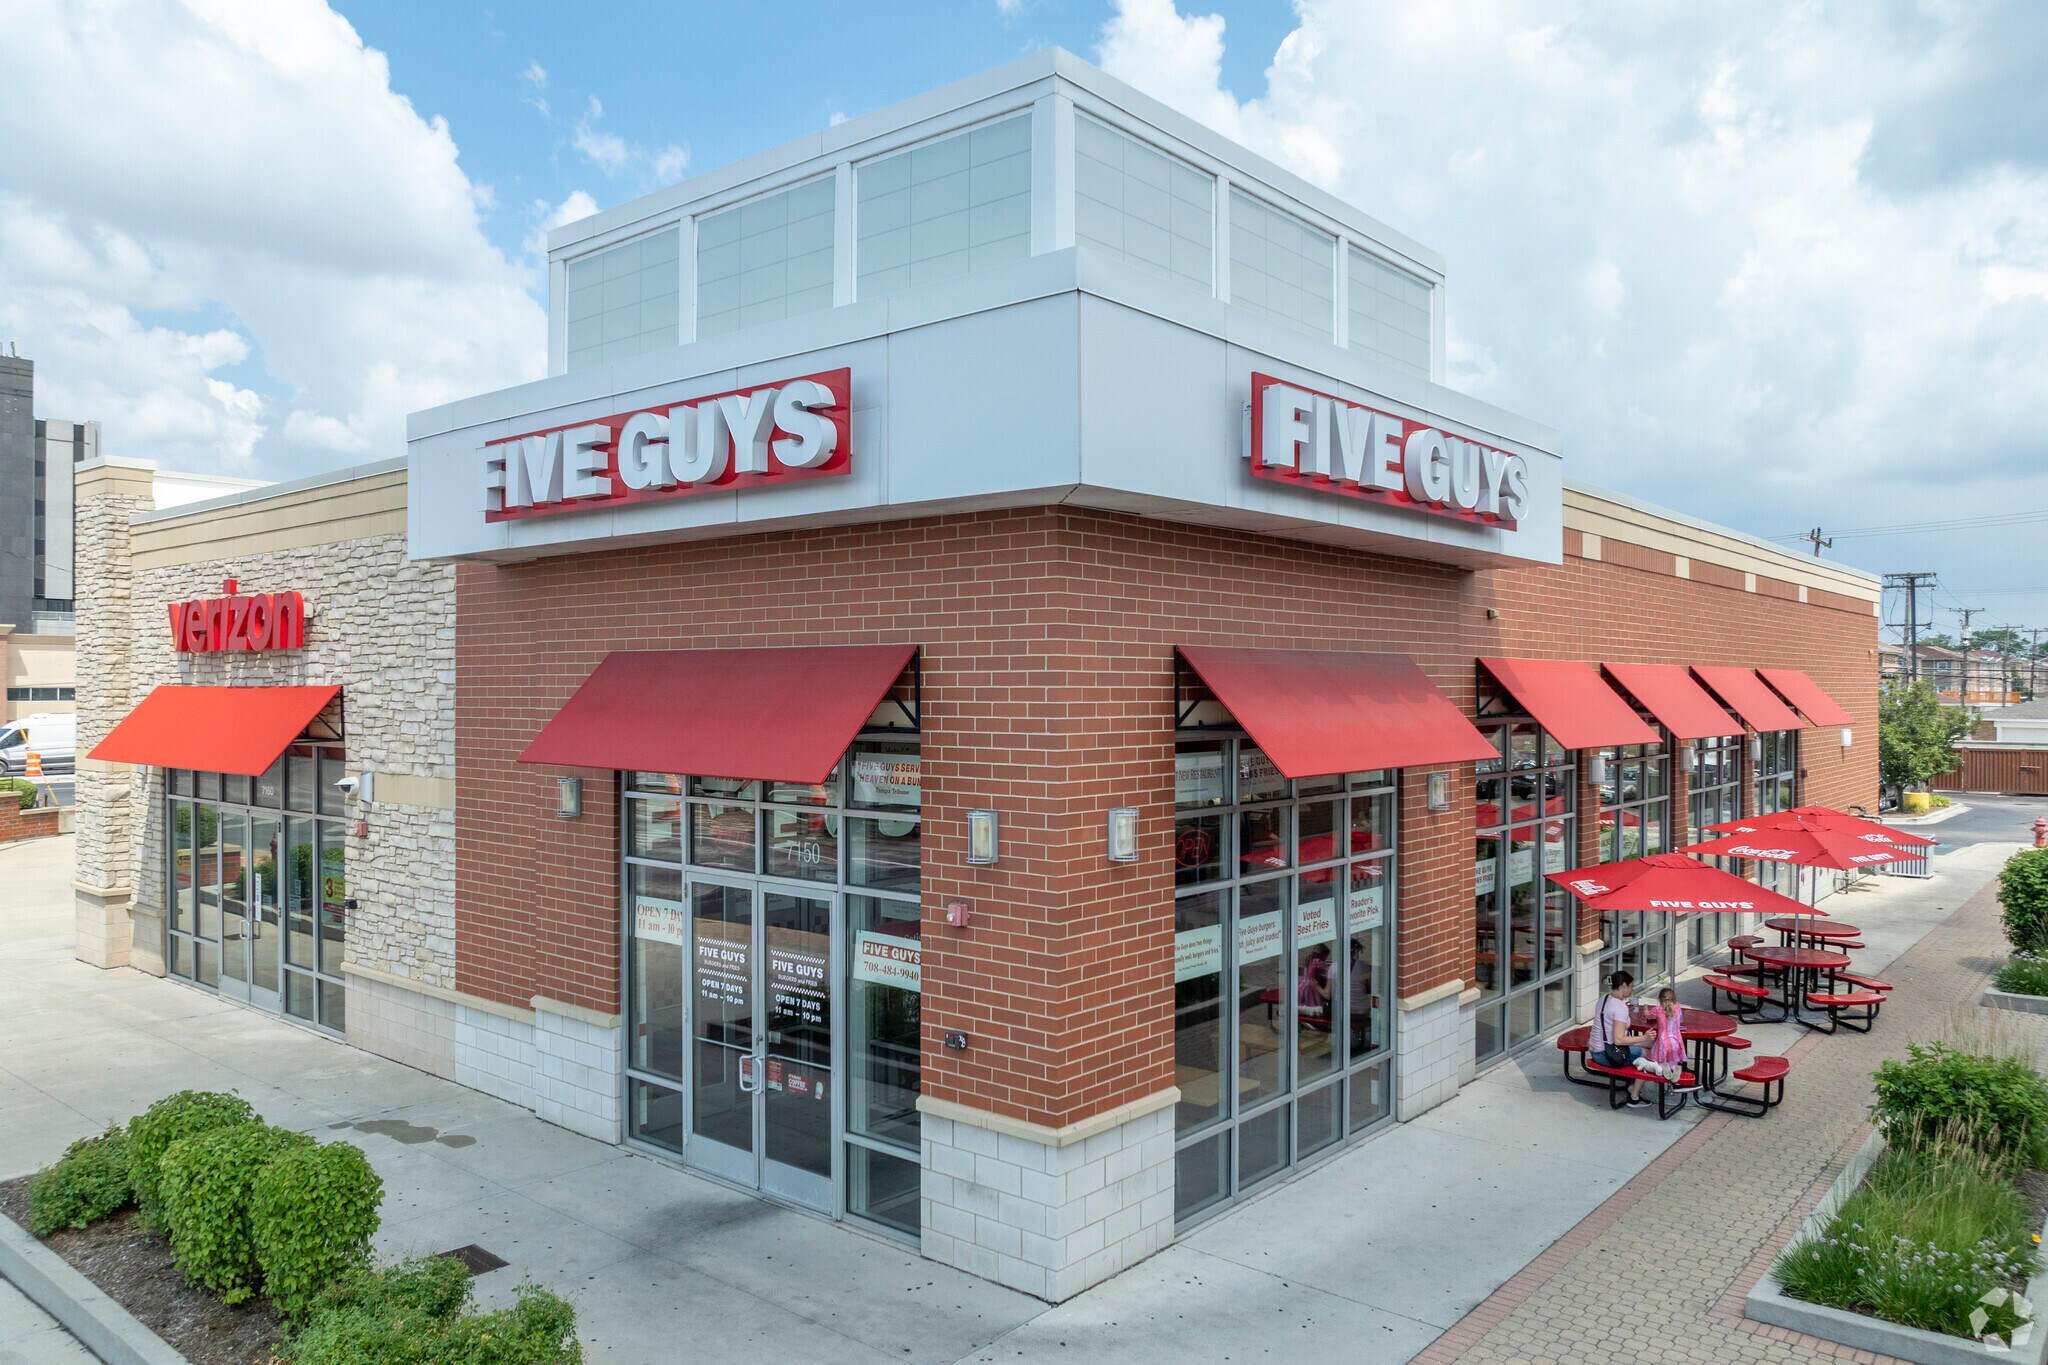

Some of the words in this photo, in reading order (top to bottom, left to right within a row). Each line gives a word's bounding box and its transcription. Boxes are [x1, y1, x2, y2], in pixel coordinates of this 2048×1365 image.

[476, 422, 611, 512] FIVE
[617, 379, 837, 491] GUYS
[1262, 382, 1403, 492] FIVE
[1403, 428, 1529, 521] GUYS
[168, 578, 304, 653] verizon
[880, 762, 899, 772] GUYS
[860, 774, 889, 784] HEAVEN
[890, 776, 899, 785] ON
[900, 777, 906, 786] A
[787, 840, 820, 864] 7150
[325, 877, 334, 898] 3
[637, 904, 661, 919] OPEN
[664, 908, 669, 919] 7
[1367, 905, 1379, 917] Pick
[1650, 900, 1695, 909] FIVE
[1698, 901, 1752, 910] GUYS
[1302, 907, 1322, 922] Voted
[638, 919, 646, 930] 11
[648, 922, 660, 932] am
[668, 924, 675, 935] 10
[1297, 923, 1312, 936] Best
[1313, 920, 1330, 932] Fries
[699, 946, 719, 958] FIVE
[721, 950, 746, 964] GUYS
[863, 942, 888, 957] FIVE
[892, 947, 920, 964] GUYS
[772, 959, 794, 973] FIVE
[796, 964, 824, 979] GUYS
[863, 961, 919, 981] 708-484-9940
[702, 979, 720, 989] OPEN
[720, 982, 725, 991] 7
[726, 984, 743, 994] DAYS
[701, 989, 708, 997] 11
[726, 995, 734, 1004] 10
[775, 994, 795, 1005] OPEN
[796, 998, 801, 1007] 7
[802, 999, 821, 1011] DAYS
[775, 1005, 782, 1013] 11
[783, 1008, 794, 1016] am
[803, 1011, 810, 1020] 10
[811, 1014, 822, 1023] pm
